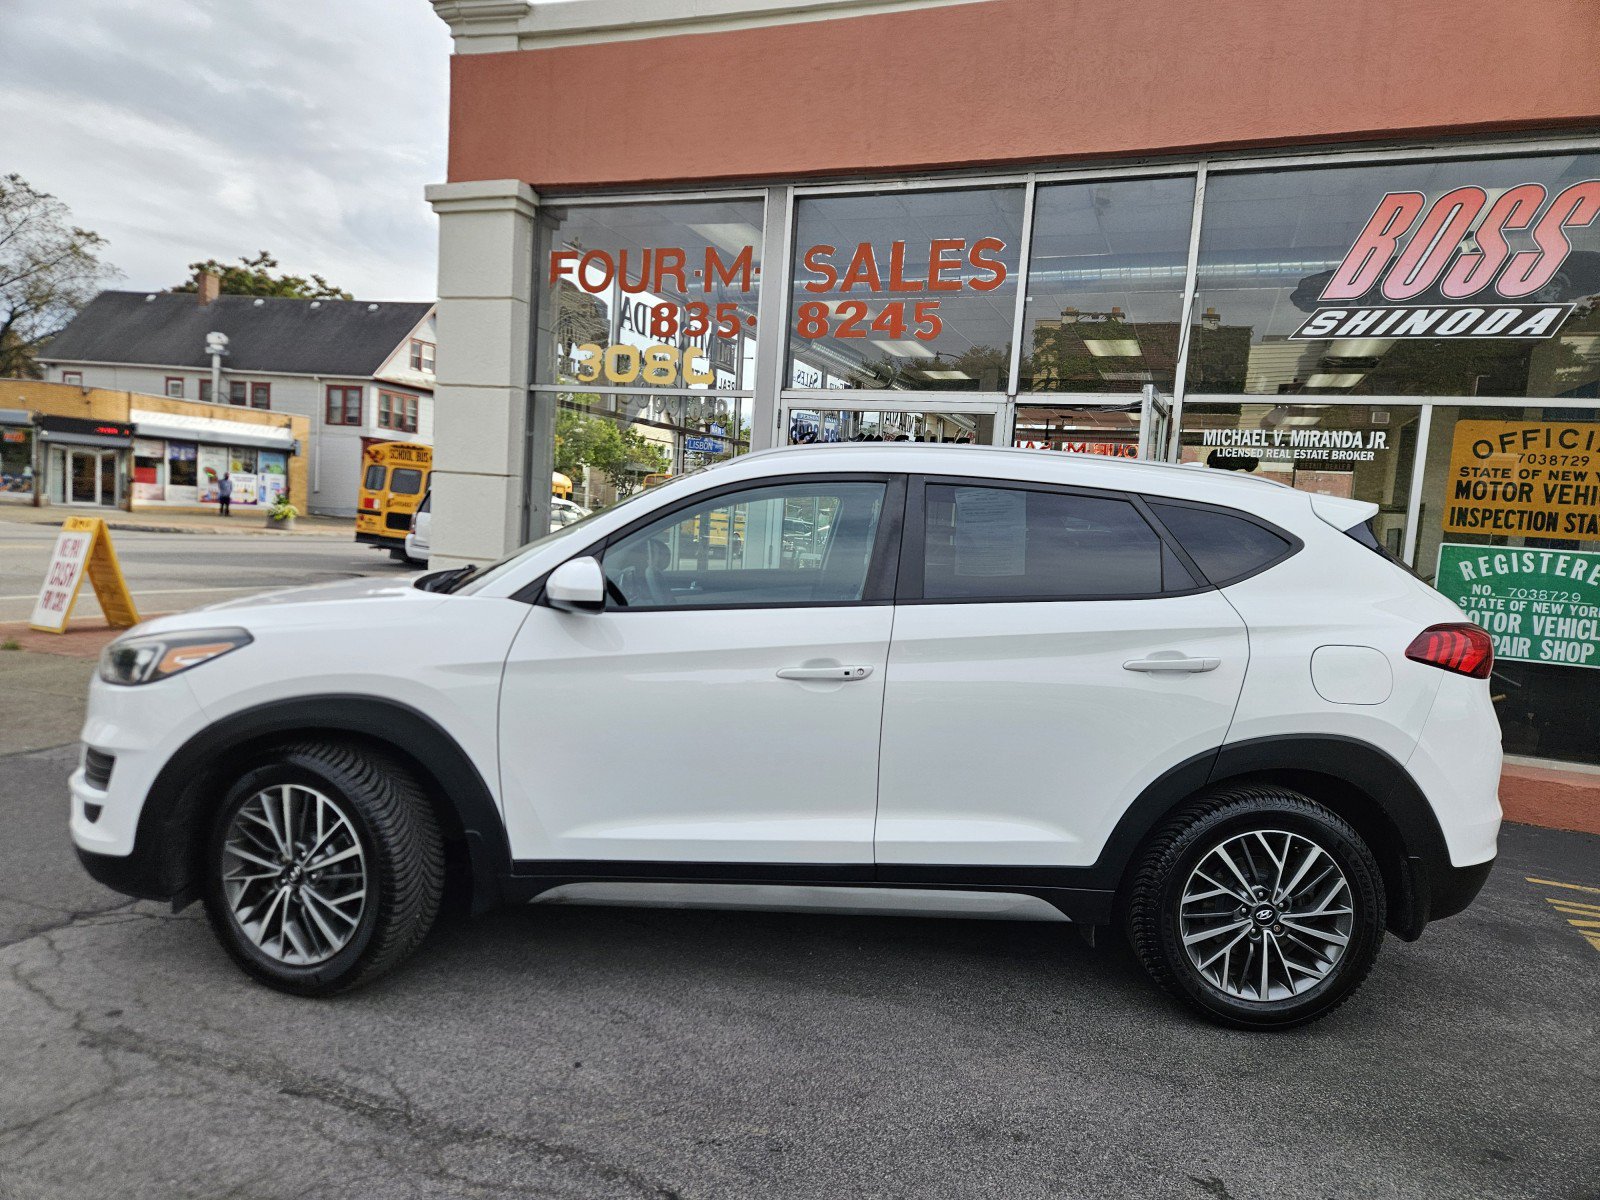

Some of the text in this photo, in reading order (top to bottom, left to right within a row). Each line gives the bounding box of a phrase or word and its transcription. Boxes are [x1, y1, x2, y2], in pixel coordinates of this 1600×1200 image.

[1318, 181, 1600, 301] BOSS
[803, 237, 1008, 294] SALES
[796, 301, 944, 341] 8245
[1301, 307, 1563, 336] SHINODA
[688, 440, 714, 451] LISBON
[1203, 429, 1390, 449] MICHAEL V. MIRANDA JR.
[1472, 428, 1600, 459] OFFICI
[1216, 448, 1375, 461] LICENSED REAL ESTATE BROKER
[1518, 453, 1590, 466] 7038729
[1460, 466, 1511, 479] STATE
[1519, 469, 1542, 480] OF
[1548, 470, 1588, 482] NEW
[1455, 480, 1600, 506] MOTOR VEHI
[1449, 507, 1600, 534] INSPECTION STA
[1471, 584, 1581, 603] NO. 7038729
[1460, 596, 1600, 618] STATE OF NEW YOR
[1463, 610, 1522, 634] OTOR
[1492, 635, 1595, 663] PAIR SHOP
